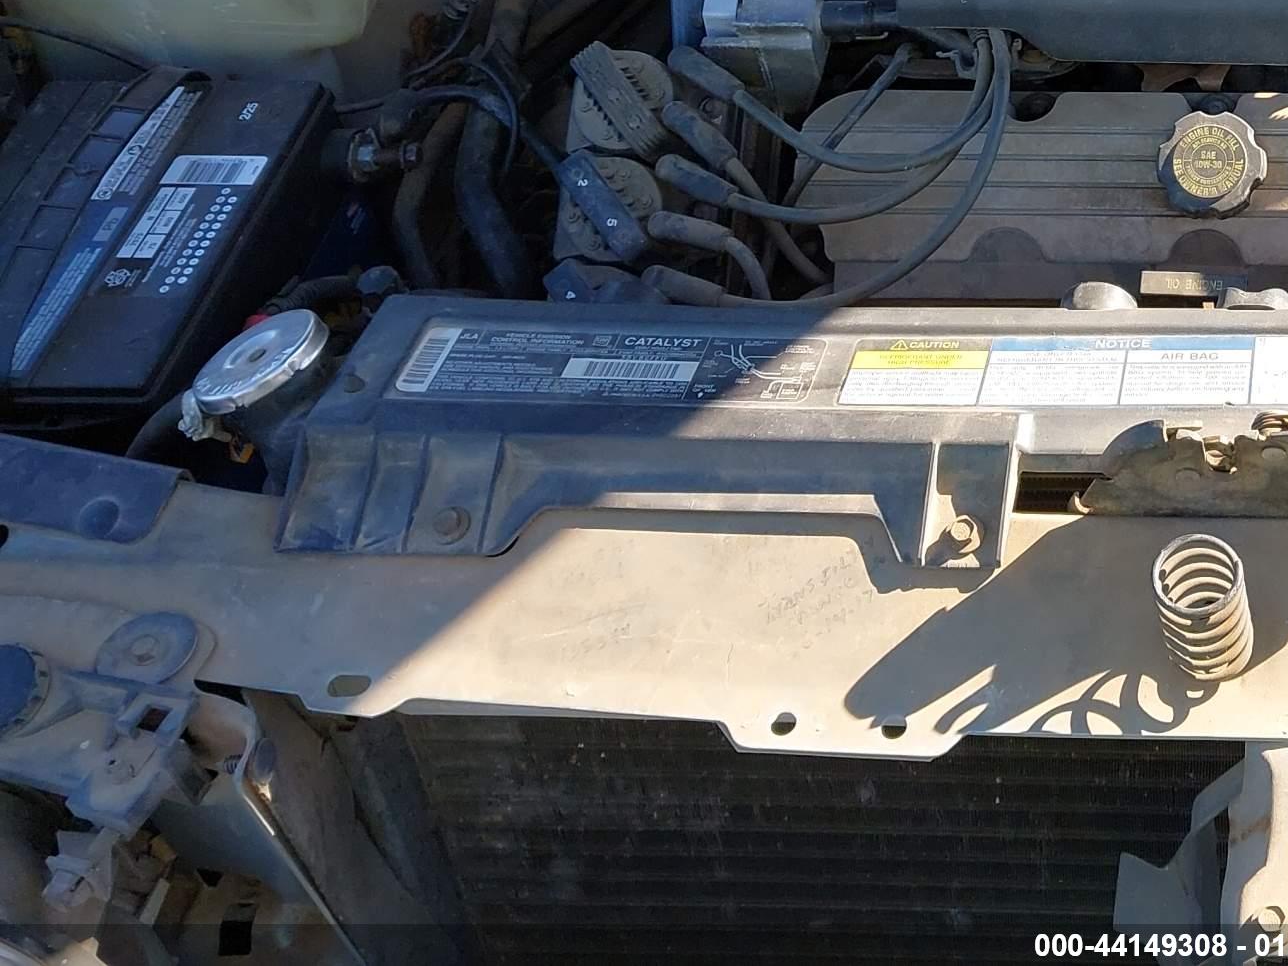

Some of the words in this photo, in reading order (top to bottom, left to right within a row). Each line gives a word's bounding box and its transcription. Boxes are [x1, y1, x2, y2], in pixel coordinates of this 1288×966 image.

[1181, 127, 1210, 148] ENGINE
[1212, 128, 1225, 138] OIL
[1225, 134, 1240, 151] FILL
[1200, 150, 1216, 160] SAE
[577, 179, 588, 187] 2
[606, 217, 617, 227] 5
[1166, 278, 1180, 289] OIL
[1185, 278, 1223, 290] ENGINE
[624, 337, 702, 347] CATALYST
[909, 341, 960, 349] CAUTION
[1095, 339, 1152, 348] NOTICE
